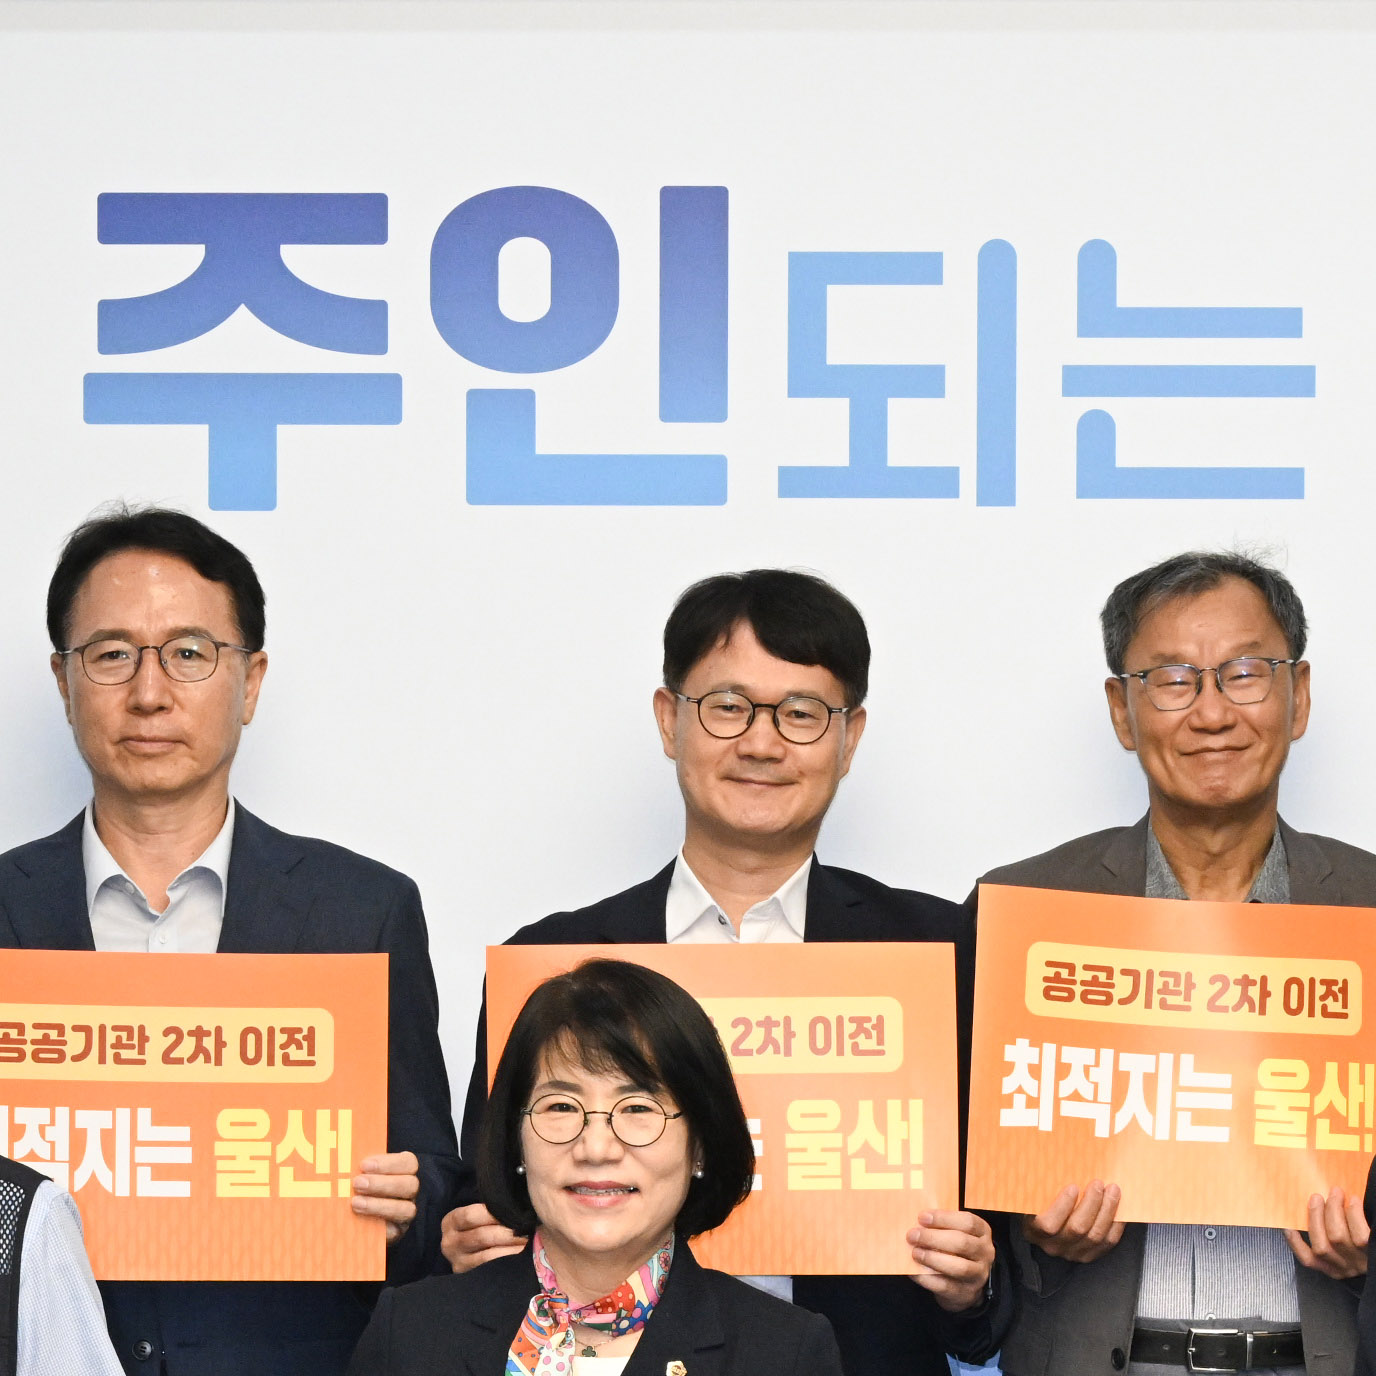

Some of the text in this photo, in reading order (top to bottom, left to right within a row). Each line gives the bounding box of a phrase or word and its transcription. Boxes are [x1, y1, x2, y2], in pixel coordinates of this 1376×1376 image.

[82, 184, 1317, 513] 주인되는
[730, 1013, 886, 1058] 2차 이전
[1041, 960, 1350, 1020] 공공기관 2차 이전
[161, 1024, 228, 1067] 2차
[239, 1025, 317, 1067] 이전
[999, 1037, 1376, 1153] 최적지는 울산!
[213, 1107, 353, 1198] 울산!
[784, 1098, 924, 1190] 울산!
